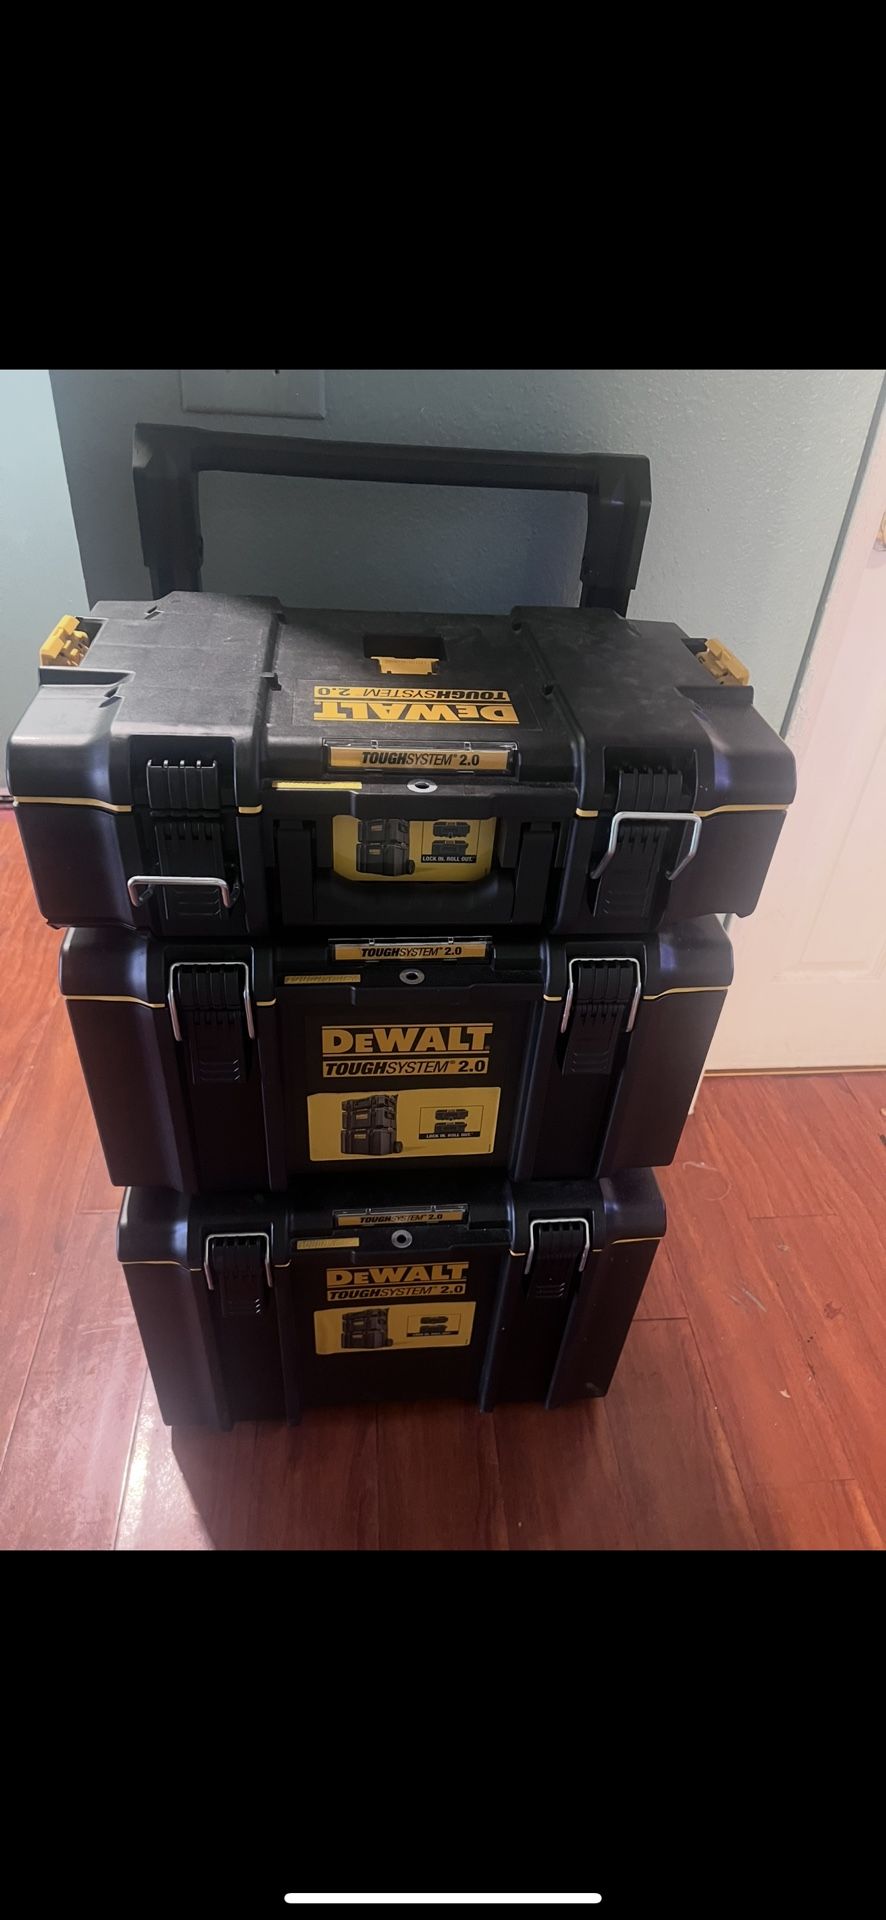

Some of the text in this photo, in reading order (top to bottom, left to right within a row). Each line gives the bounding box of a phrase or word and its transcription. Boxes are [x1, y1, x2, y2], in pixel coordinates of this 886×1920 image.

[317, 687, 507, 700] TOUGHSYSTEM 2.0
[362, 752, 480, 766] TOUGHSYSTEM 2.0
[362, 947, 462, 957] TOUGHSYSTEM 2.0
[326, 1060, 485, 1075] TOUGHSYSTEM 2.0
[330, 1286, 433, 1299] TOUGHSYSTEM
